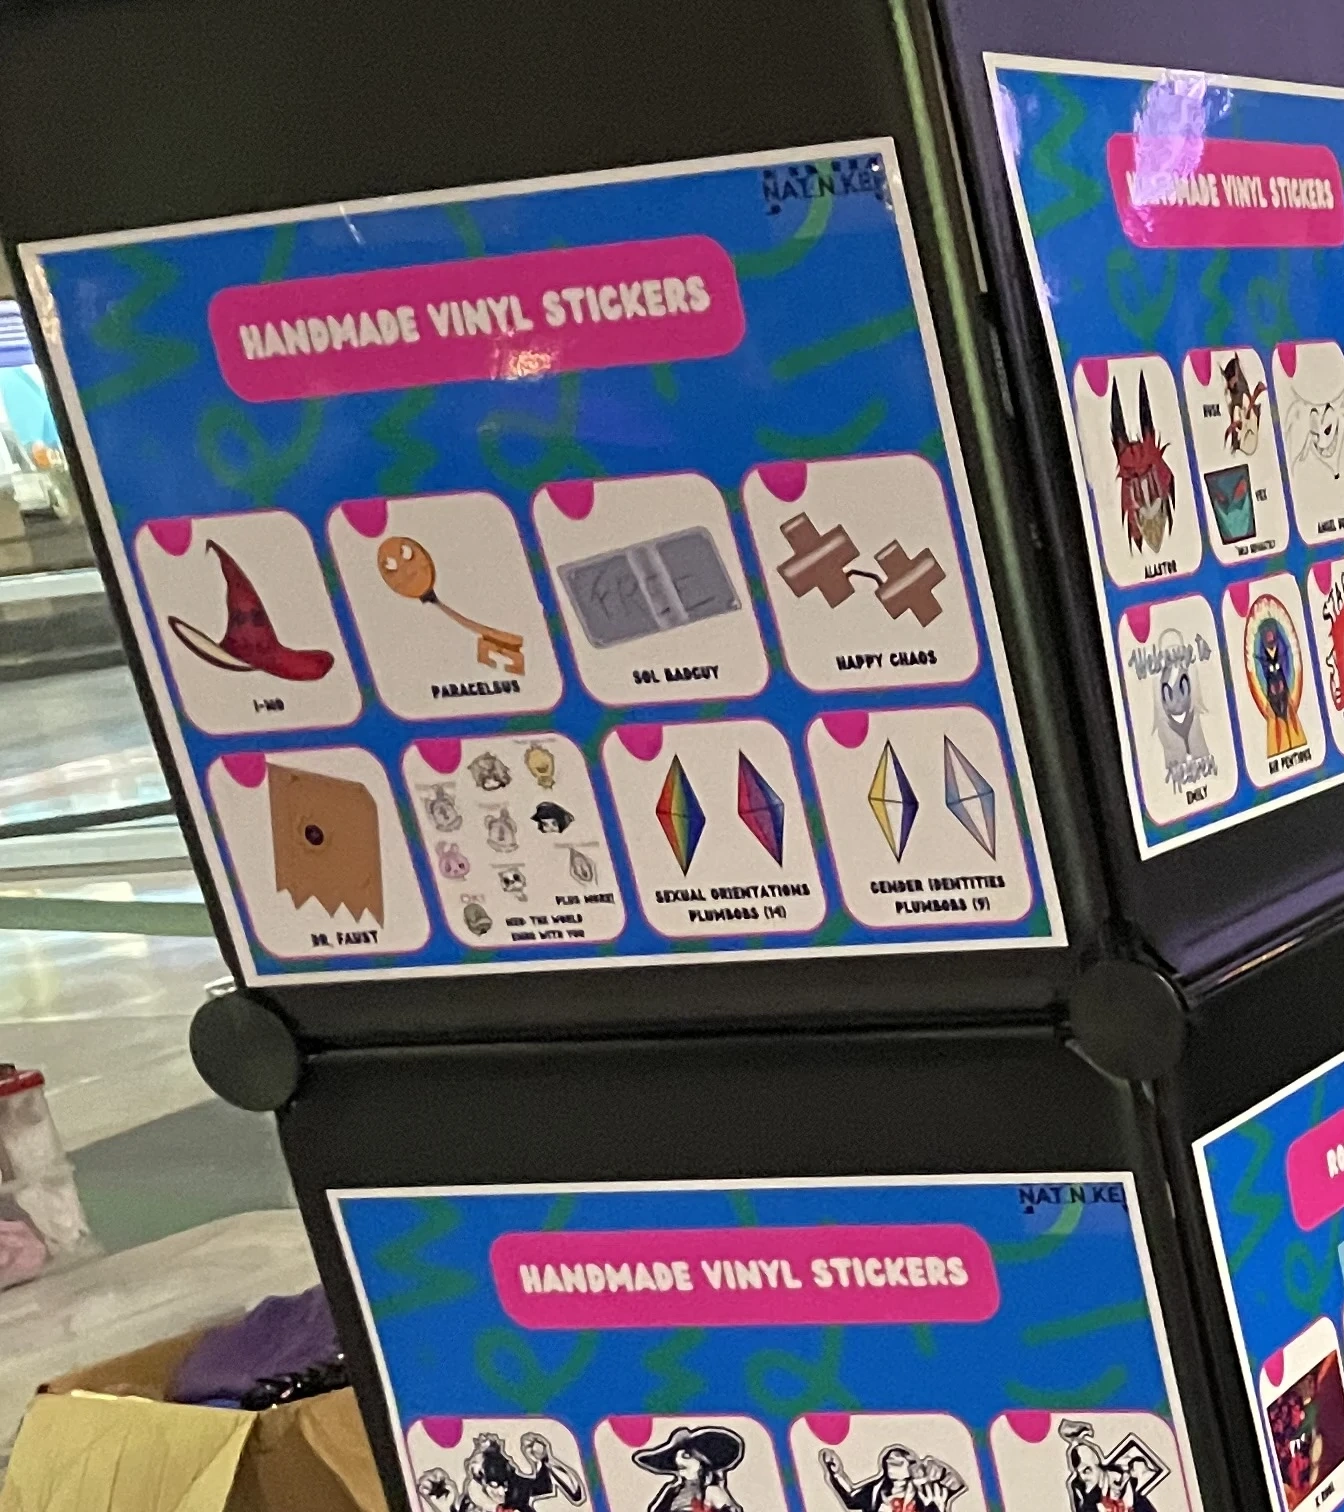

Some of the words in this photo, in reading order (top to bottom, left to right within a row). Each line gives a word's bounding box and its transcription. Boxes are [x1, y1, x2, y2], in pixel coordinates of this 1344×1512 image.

[1221, 173, 1268, 208] VINYL
[1271, 178, 1334, 210] STICKERS
[239, 305, 420, 362] HANDMADE
[427, 295, 533, 341] VINYL
[543, 276, 710, 328] STICKERS
[1144, 560, 1178, 578] ALASTOR
[836, 653, 883, 671] HAPPY
[889, 650, 937, 667] CHAOS
[633, 669, 659, 684] SOL
[665, 666, 719, 682] BADGUY
[431, 680, 520, 698] PARACELSUS
[655, 887, 706, 904] SEXUAL
[710, 882, 811, 901] ORIENTATIONS
[870, 878, 924, 894] GENDER
[927, 875, 1006, 892] IDENTITIES
[337, 930, 379, 947] FAUST
[1018, 1187, 1062, 1204] NAT
[1070, 1186, 1085, 1204] N
[519, 1261, 694, 1296] HANDMADE
[701, 1258, 802, 1292] VINYL
[811, 1256, 969, 1288] STICKERS
